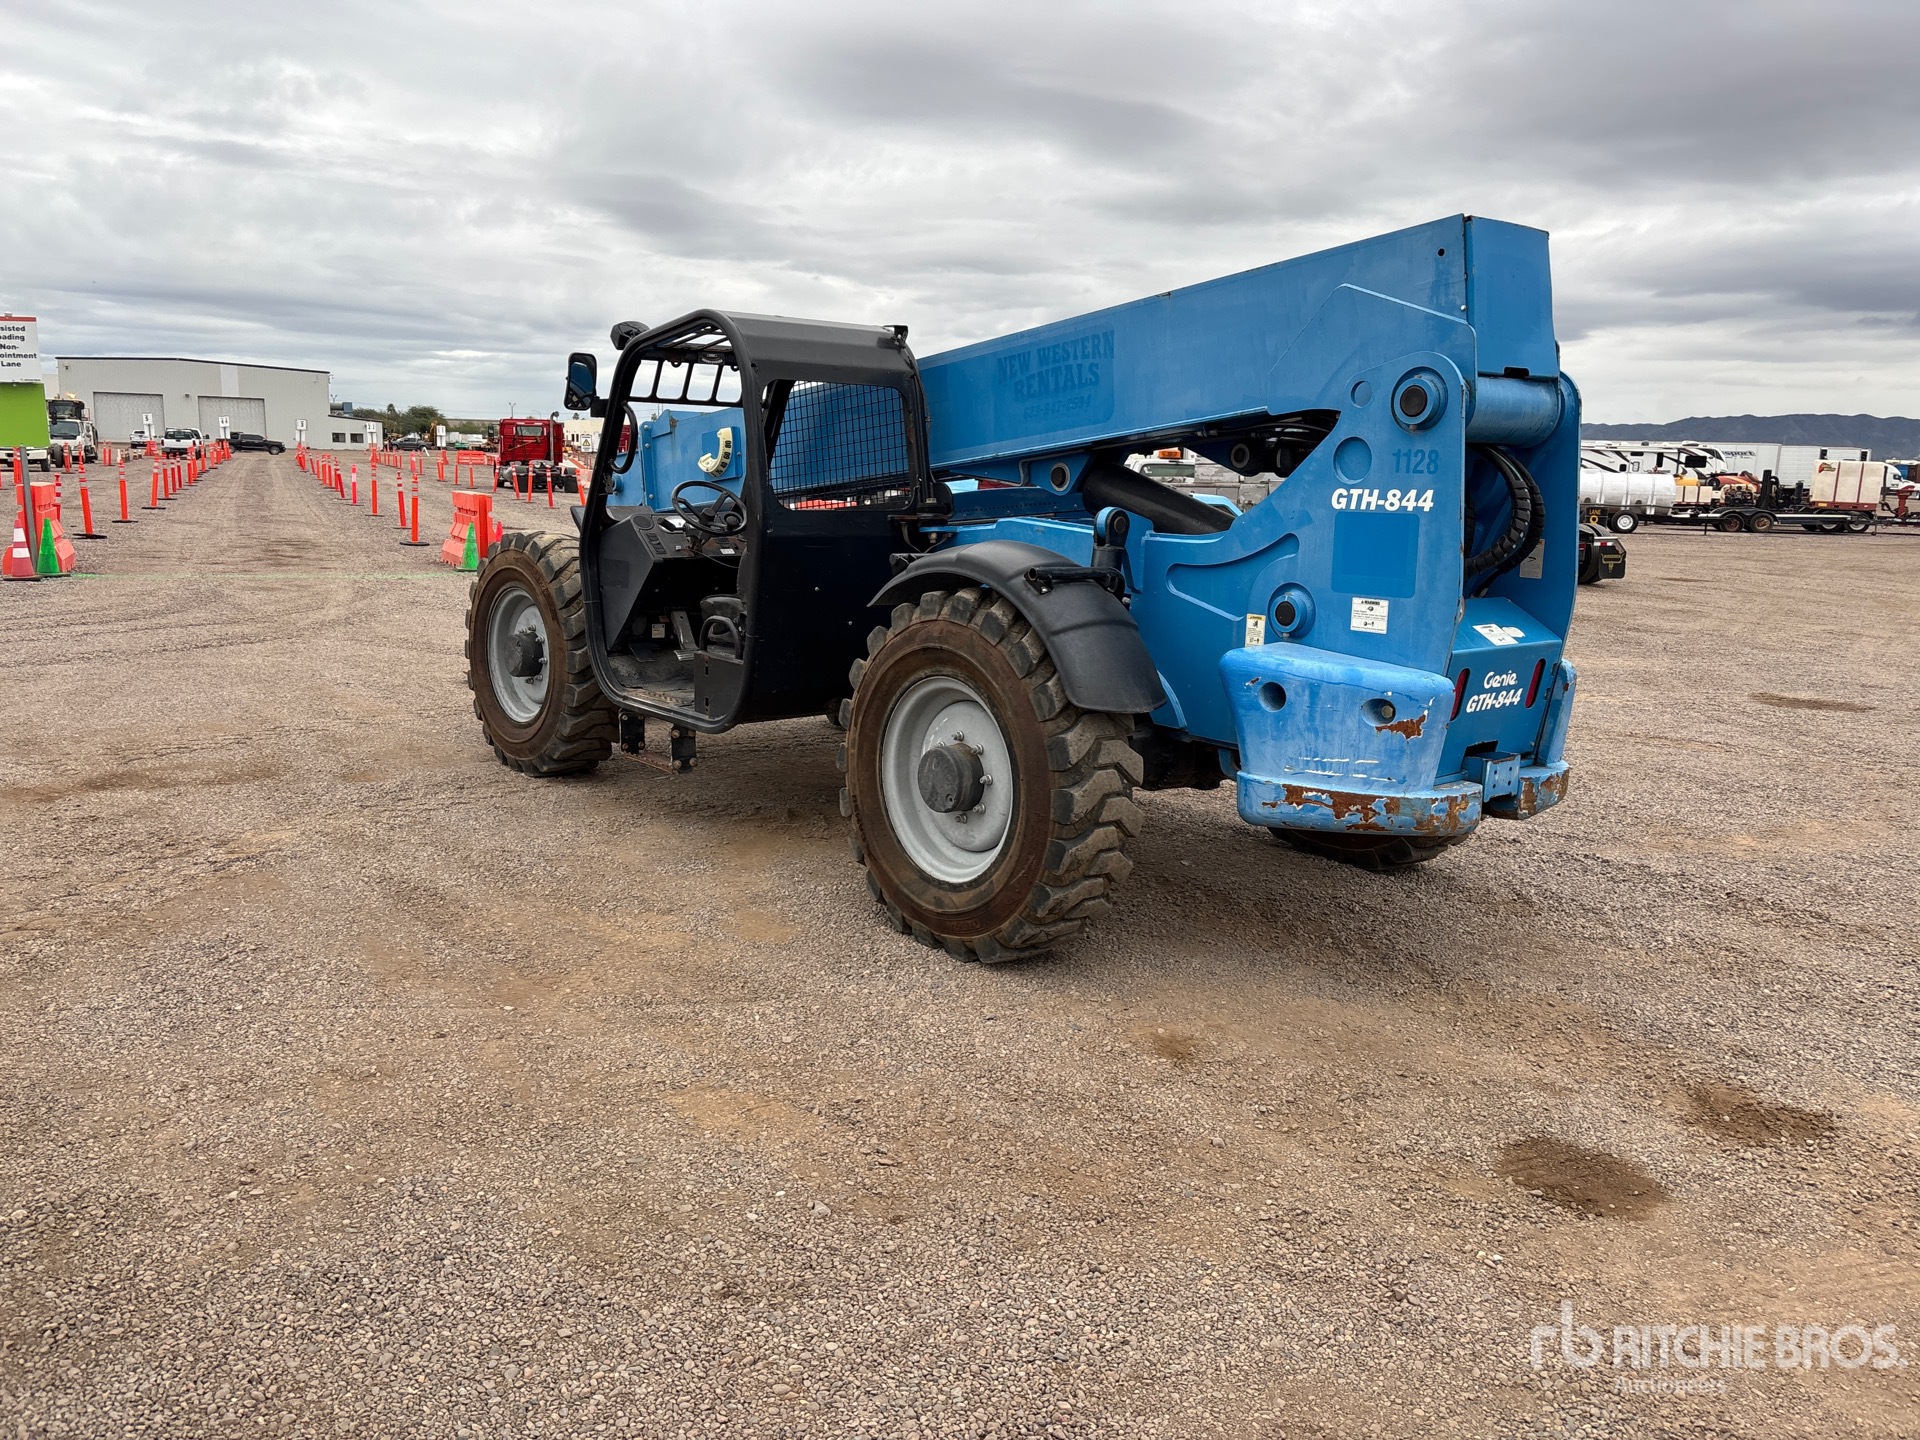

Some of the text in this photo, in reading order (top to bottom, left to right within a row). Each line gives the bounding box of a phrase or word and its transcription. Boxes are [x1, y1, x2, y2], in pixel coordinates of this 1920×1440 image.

[997, 329, 1115, 385] NEW WESTERN
[1013, 362, 1100, 402] RENTALS
[725, 440, 732, 448] 80
[1391, 448, 1440, 475] 1128
[1331, 487, 1434, 512] GTH-844
[1483, 669, 1517, 689] Genie
[1466, 687, 1524, 714] GTH-844
